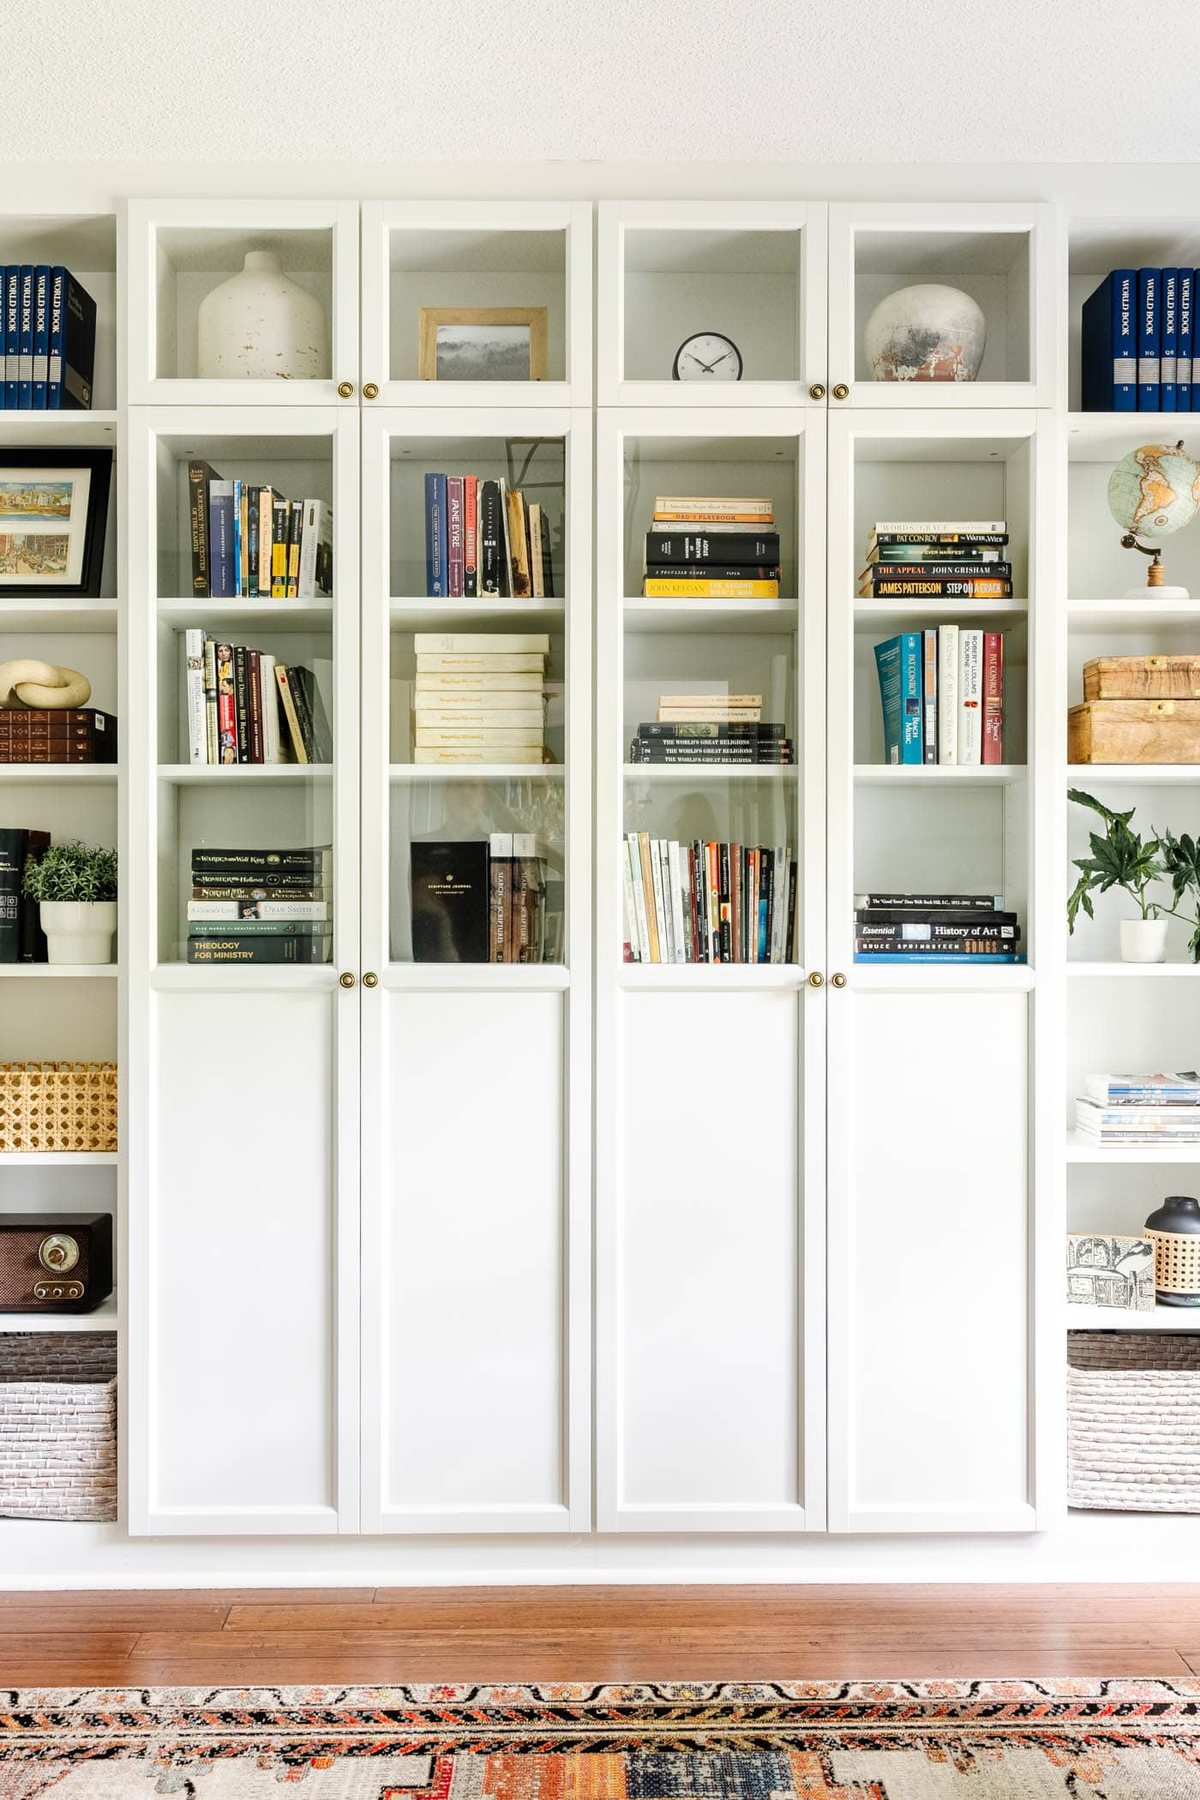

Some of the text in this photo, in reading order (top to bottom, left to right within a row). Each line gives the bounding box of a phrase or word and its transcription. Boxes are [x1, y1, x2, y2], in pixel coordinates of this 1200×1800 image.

[23, 275, 31, 332] WORLD BOOK
[879, 583, 902, 594] JAMES
[903, 583, 941, 594] PATTERSON
[947, 583, 962, 594] STEP
[963, 583, 973, 594] ON
[908, 666, 916, 695] CONROY
[935, 927, 968, 936] History
[966, 940, 996, 953] SONGS
